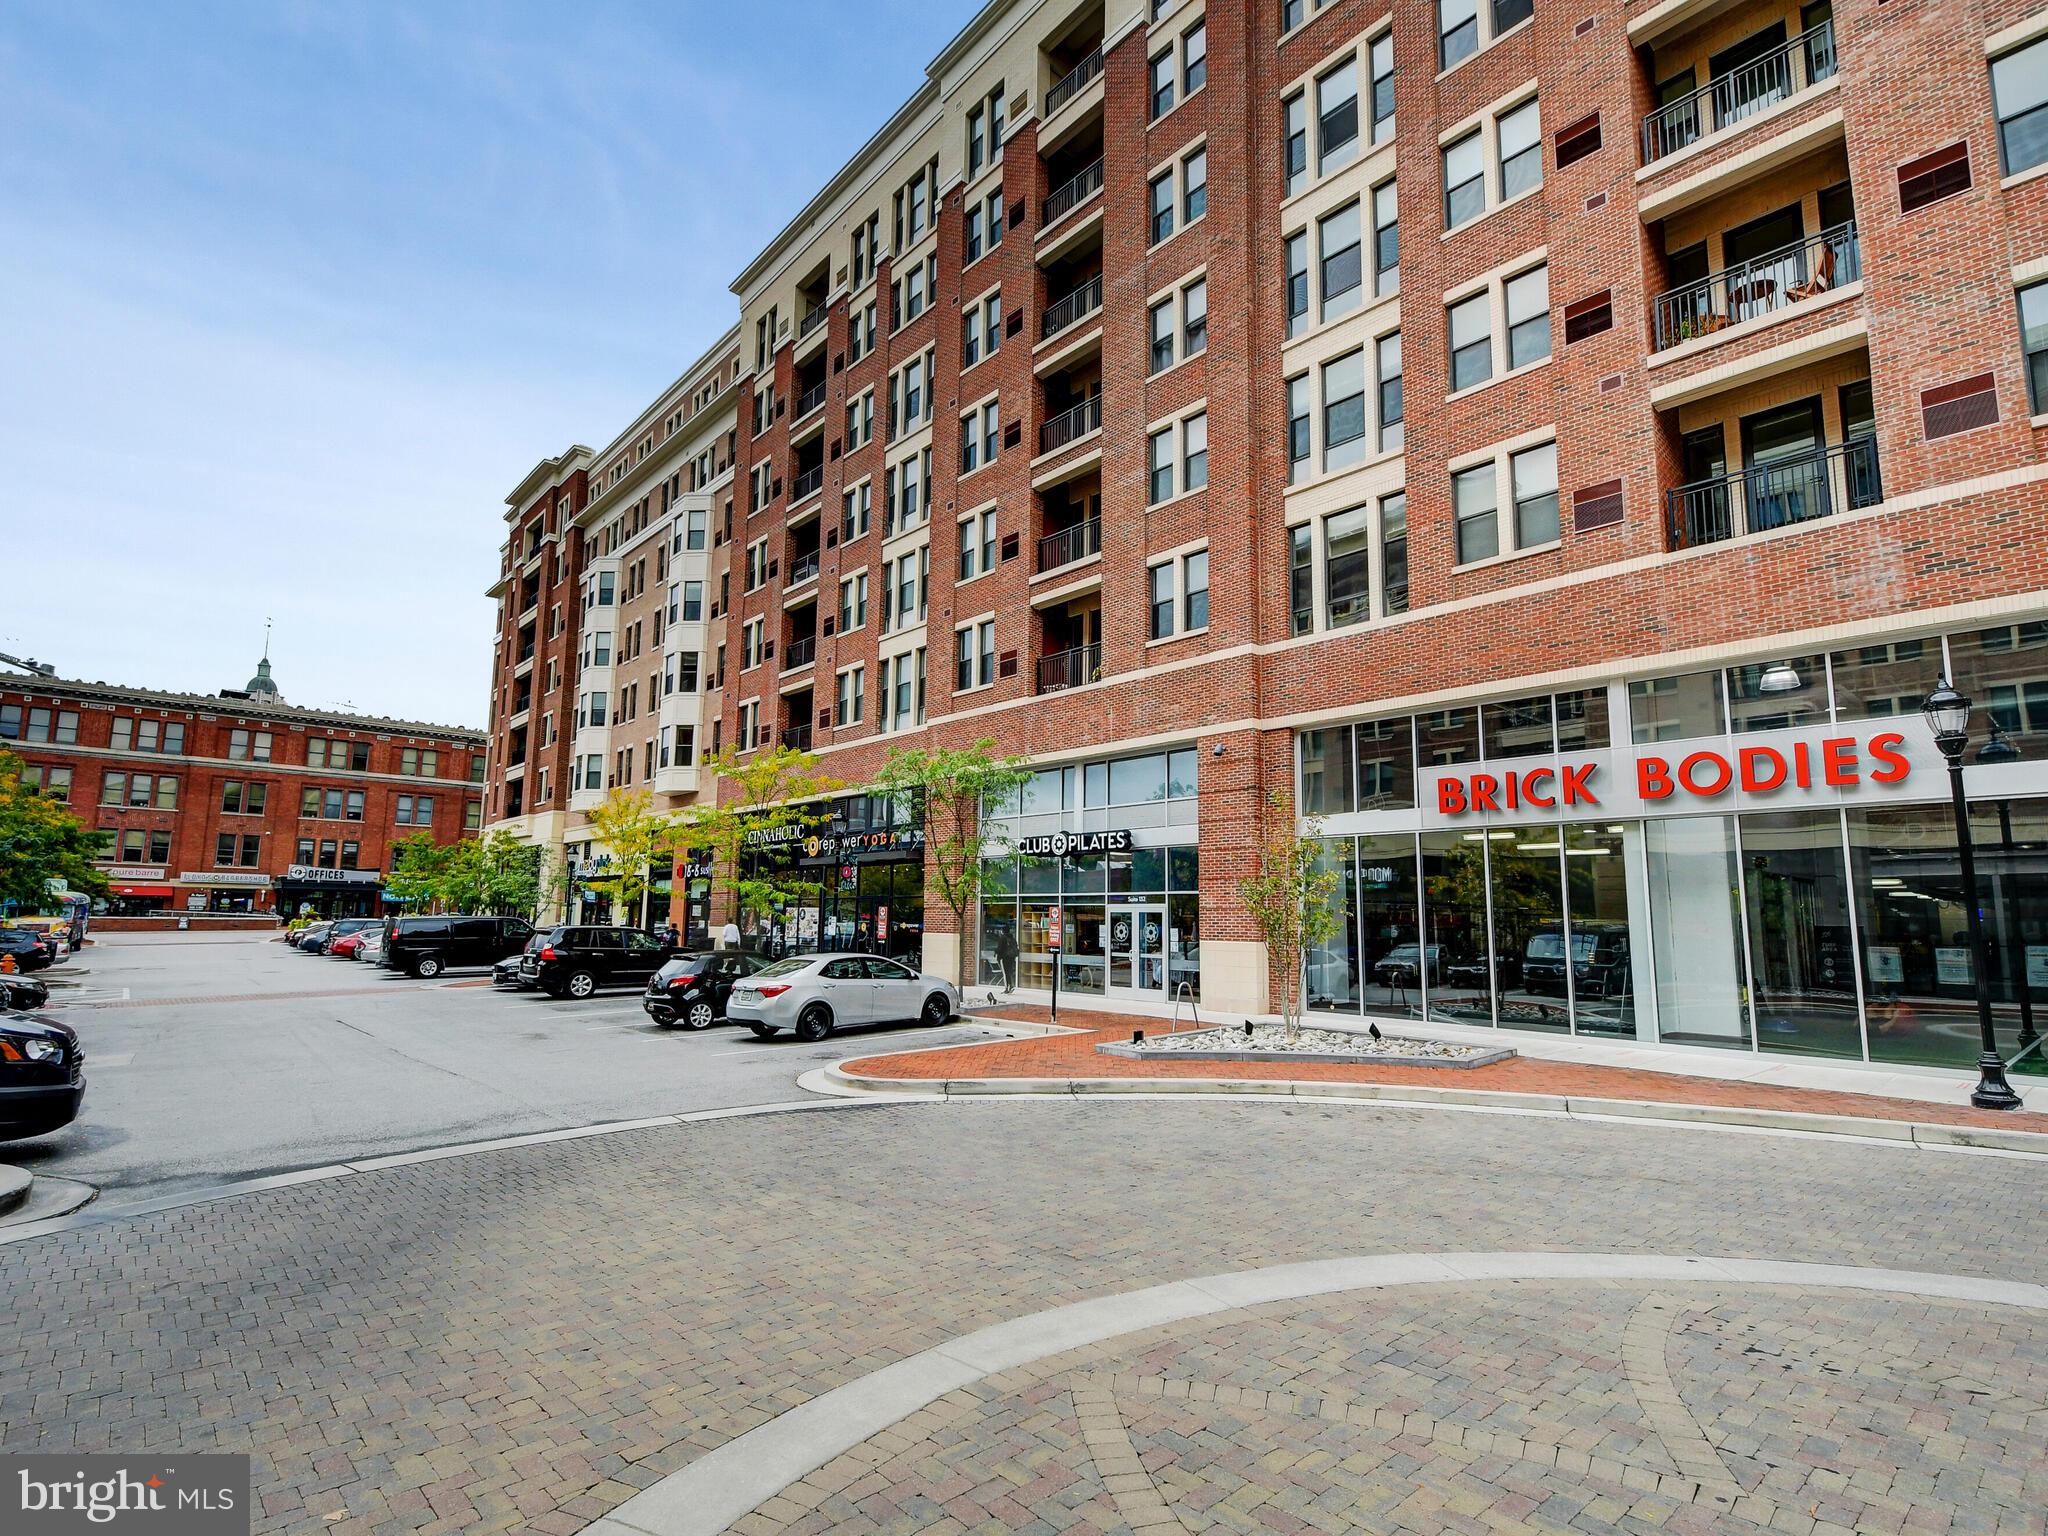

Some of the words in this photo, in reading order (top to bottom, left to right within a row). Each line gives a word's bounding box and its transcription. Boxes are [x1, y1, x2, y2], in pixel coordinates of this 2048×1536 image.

[1438, 763, 1601, 814] BRICK
[1637, 732, 1911, 799] BODIES
[748, 824, 805, 845] CINNAHOLIC
[802, 835, 861, 856] corepwer
[863, 832, 896, 846] YOGA
[1018, 835, 1050, 855] CLUB
[1068, 831, 1125, 851] PILATES
[112, 868, 134, 879] pure
[135, 868, 159, 878] barre
[308, 869, 345, 880] OFFICES
